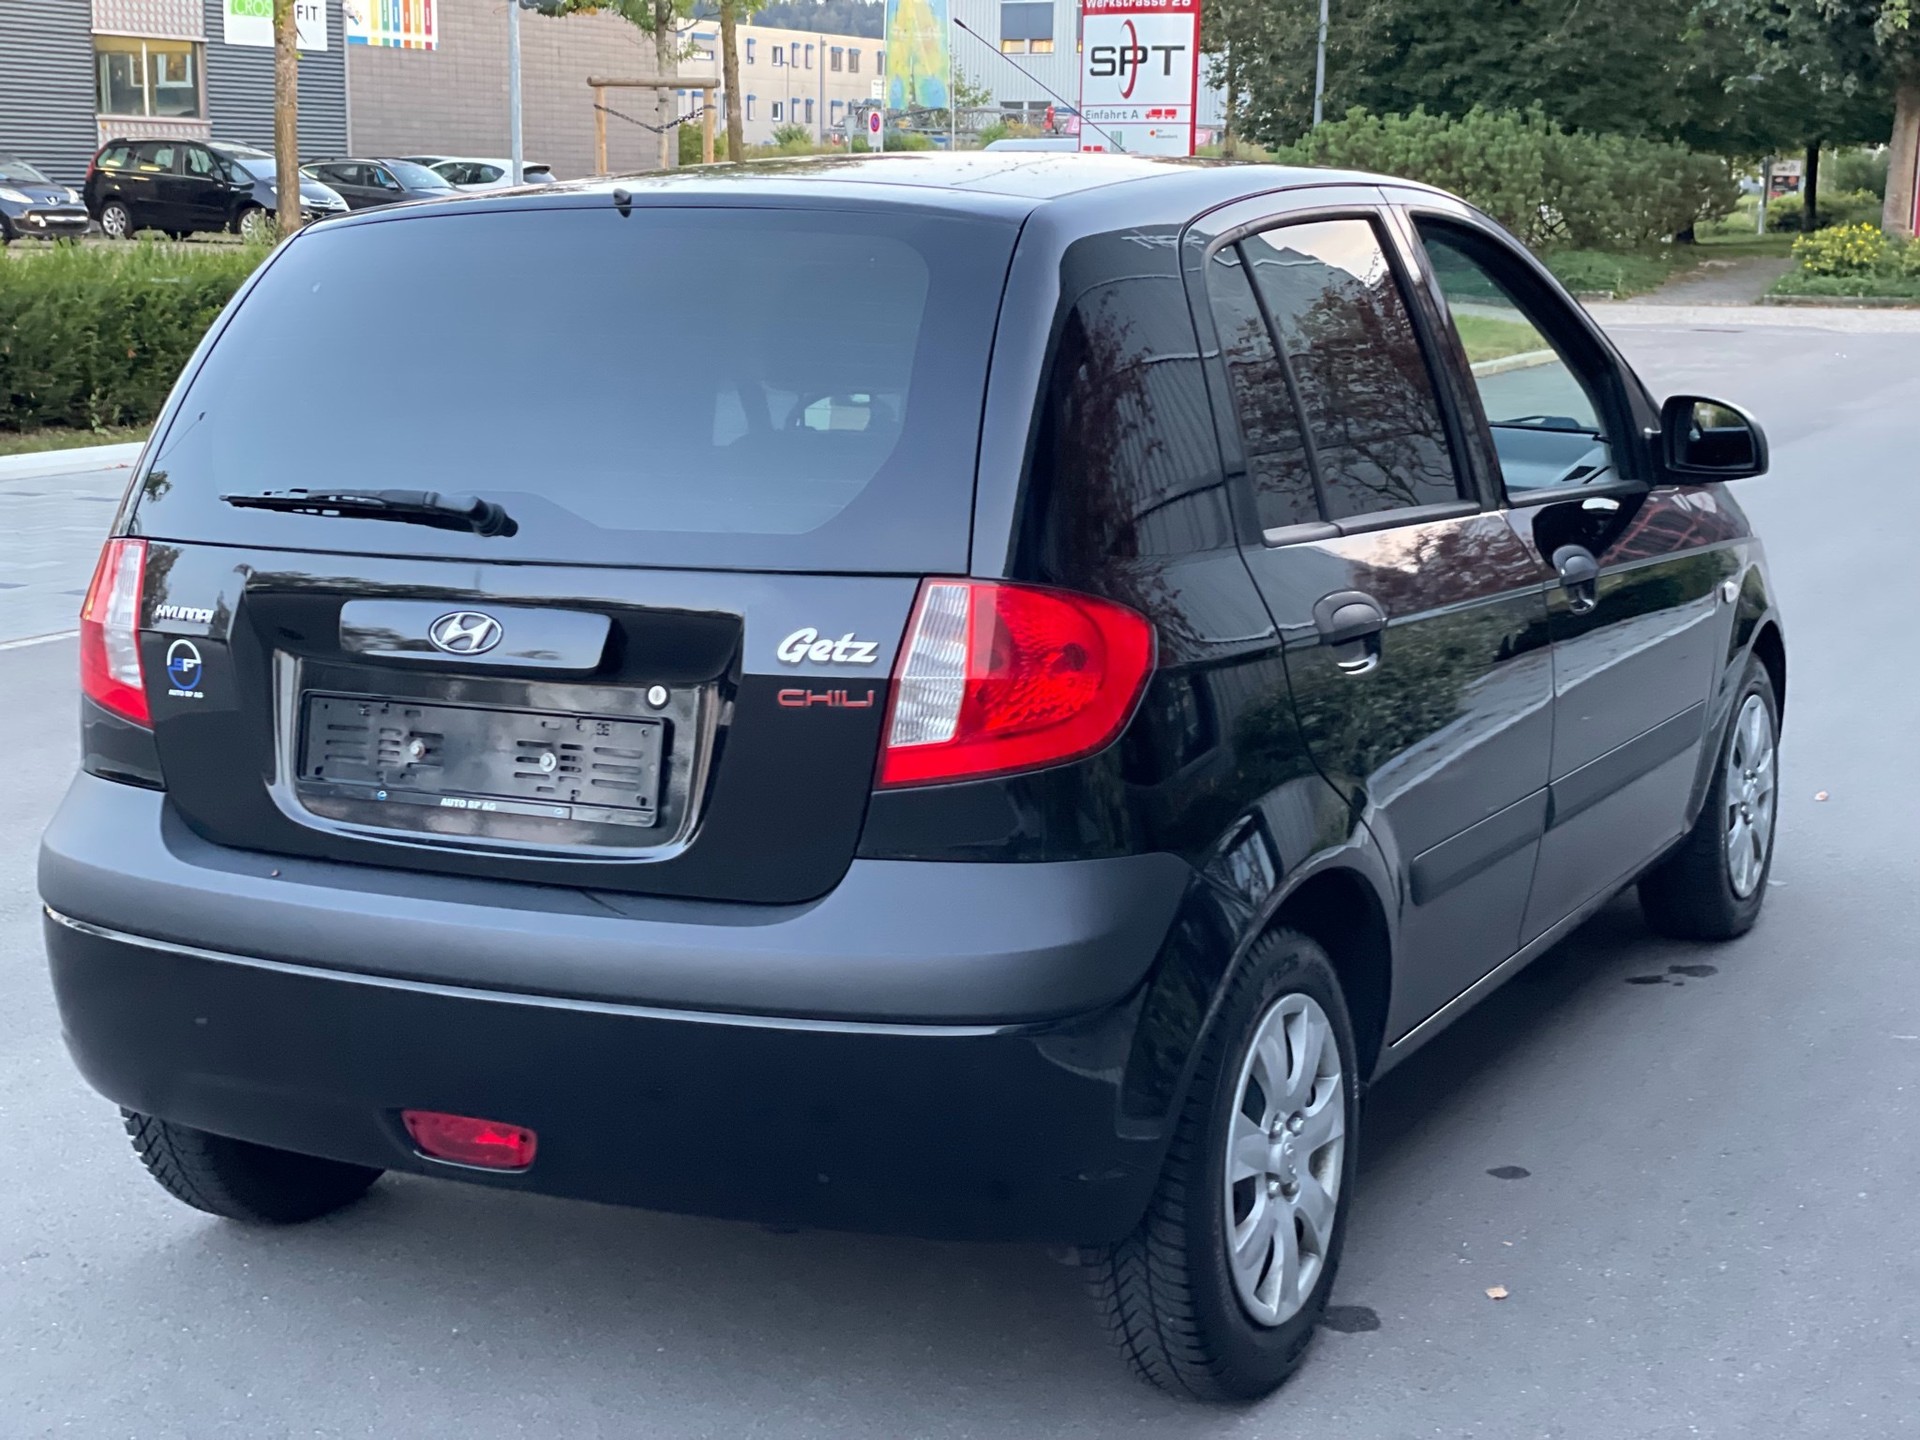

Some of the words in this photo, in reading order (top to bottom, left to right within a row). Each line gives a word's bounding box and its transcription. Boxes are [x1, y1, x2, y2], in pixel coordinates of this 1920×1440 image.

[296, 5, 318, 20] FIT
[1089, 45, 1185, 76] SPT
[1085, 109, 1127, 119] Einfahrt
[1131, 109, 1139, 119] A
[155, 604, 214, 624] HYUNDAI
[776, 627, 879, 664] Getz
[777, 688, 874, 707] CHILI
[440, 797, 466, 808] AUTO
